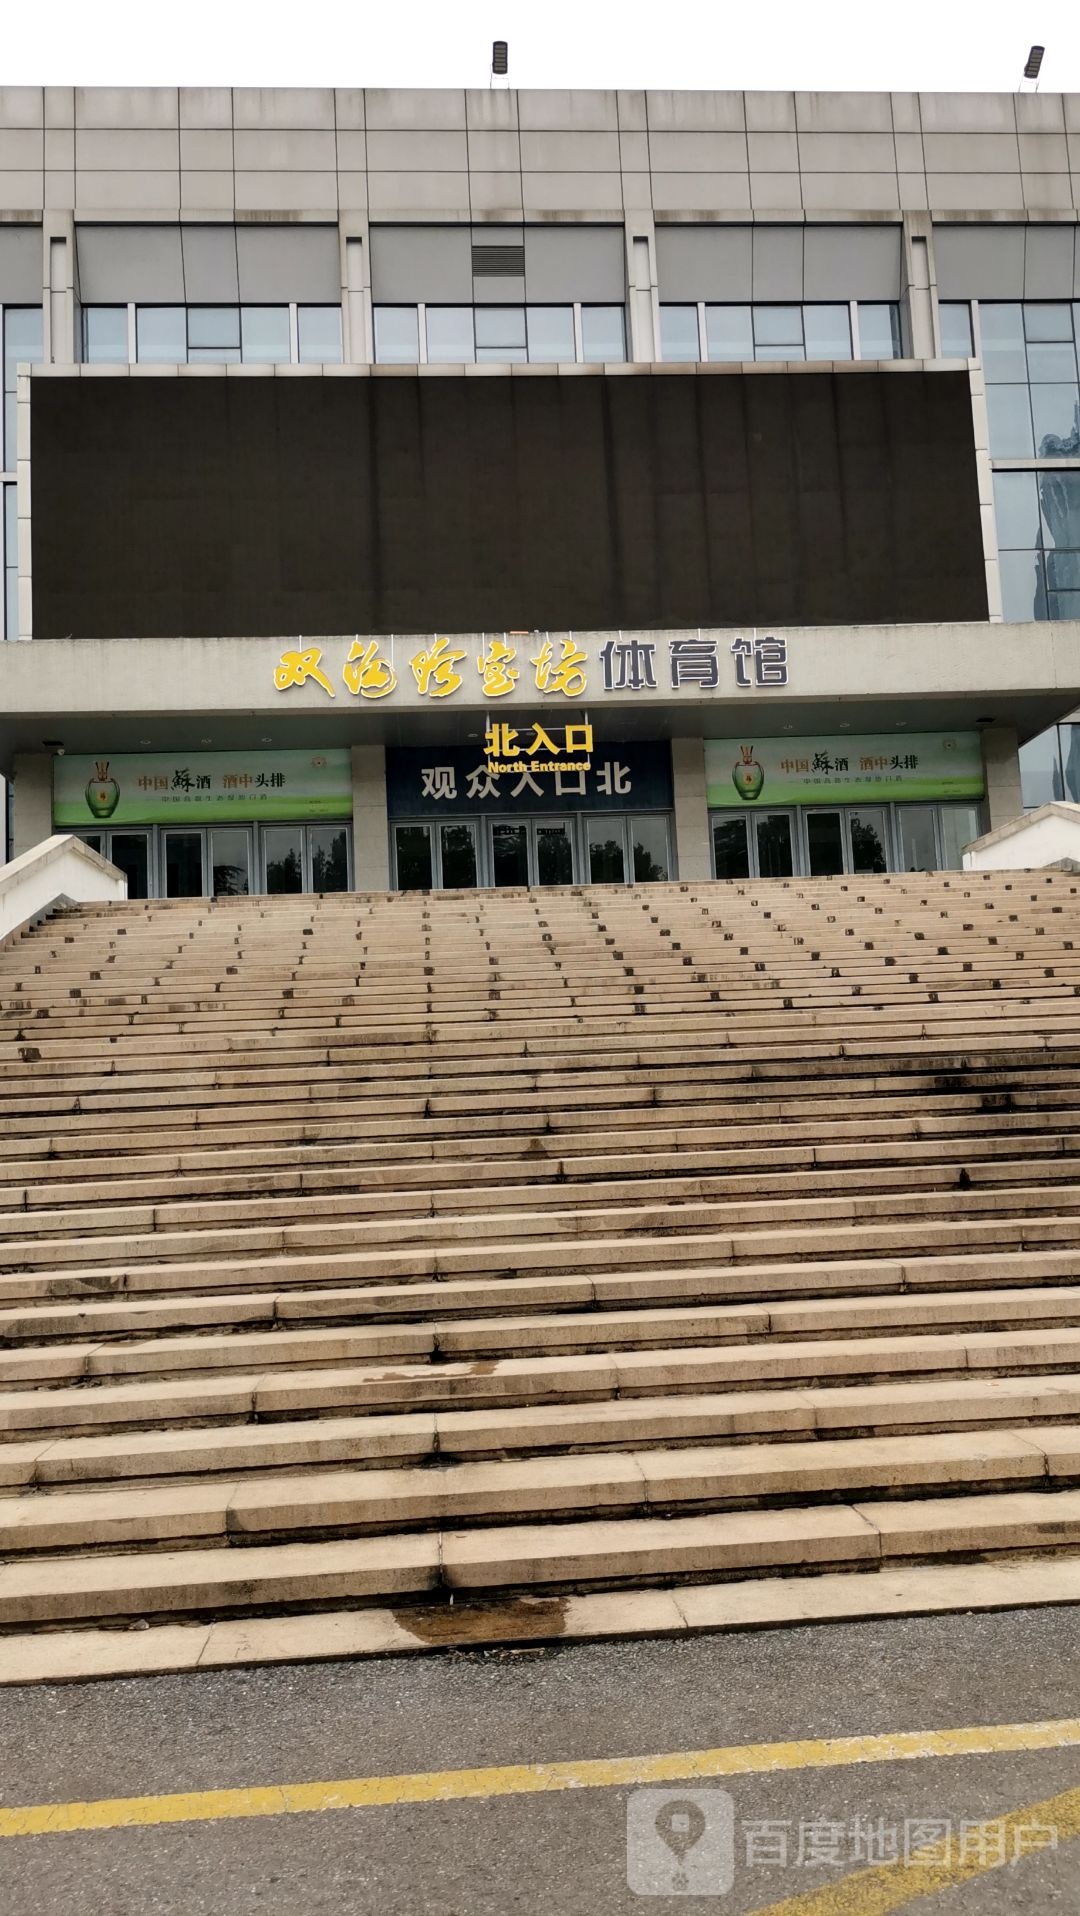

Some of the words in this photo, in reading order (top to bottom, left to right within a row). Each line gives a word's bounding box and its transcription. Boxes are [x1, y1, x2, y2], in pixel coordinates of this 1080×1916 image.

[483, 722, 594, 757] 北入口
[488, 762, 526, 773] North
[531, 760, 591, 771] Entrance
[859, 754, 919, 772] 酒中头排
[223, 772, 286, 789] 酒中头排
